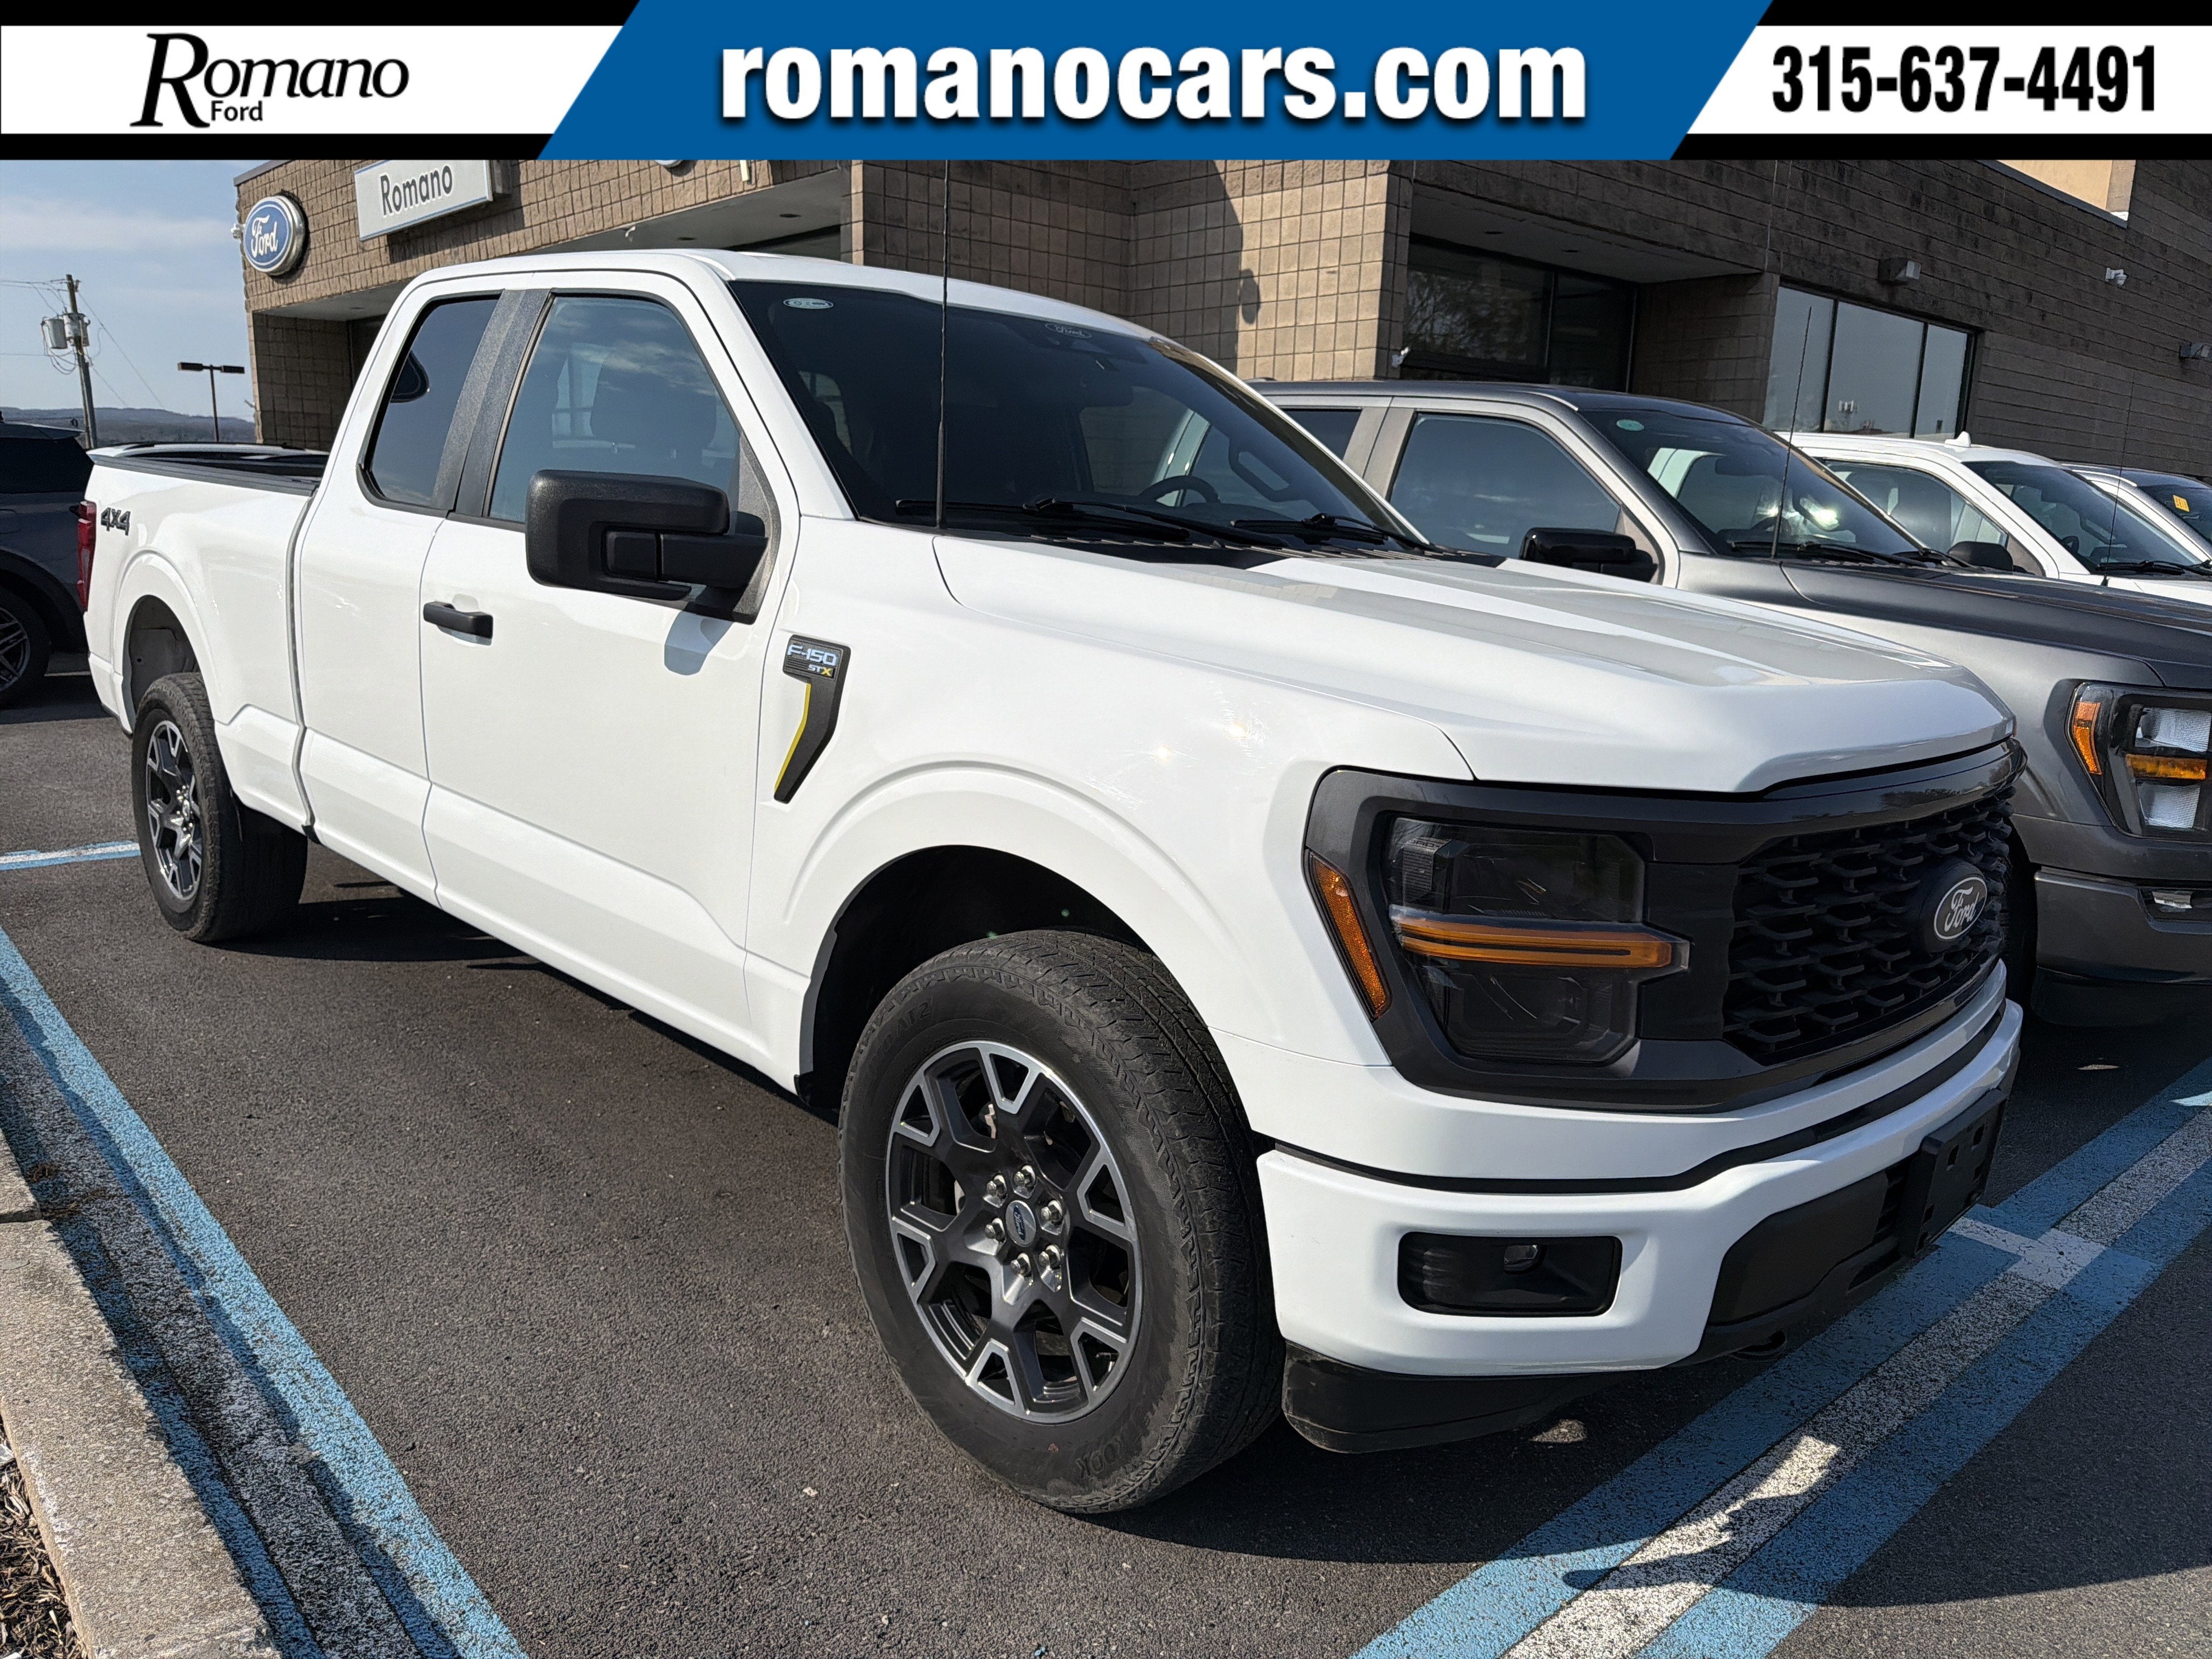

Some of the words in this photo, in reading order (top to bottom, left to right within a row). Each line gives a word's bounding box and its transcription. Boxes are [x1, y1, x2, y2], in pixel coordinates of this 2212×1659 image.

[380, 165, 453, 216] Romano
[251, 214, 278, 258] Ford
[787, 644, 837, 667] F-150
[807, 664, 832, 677] STX
[1944, 886, 1980, 932] Ford
